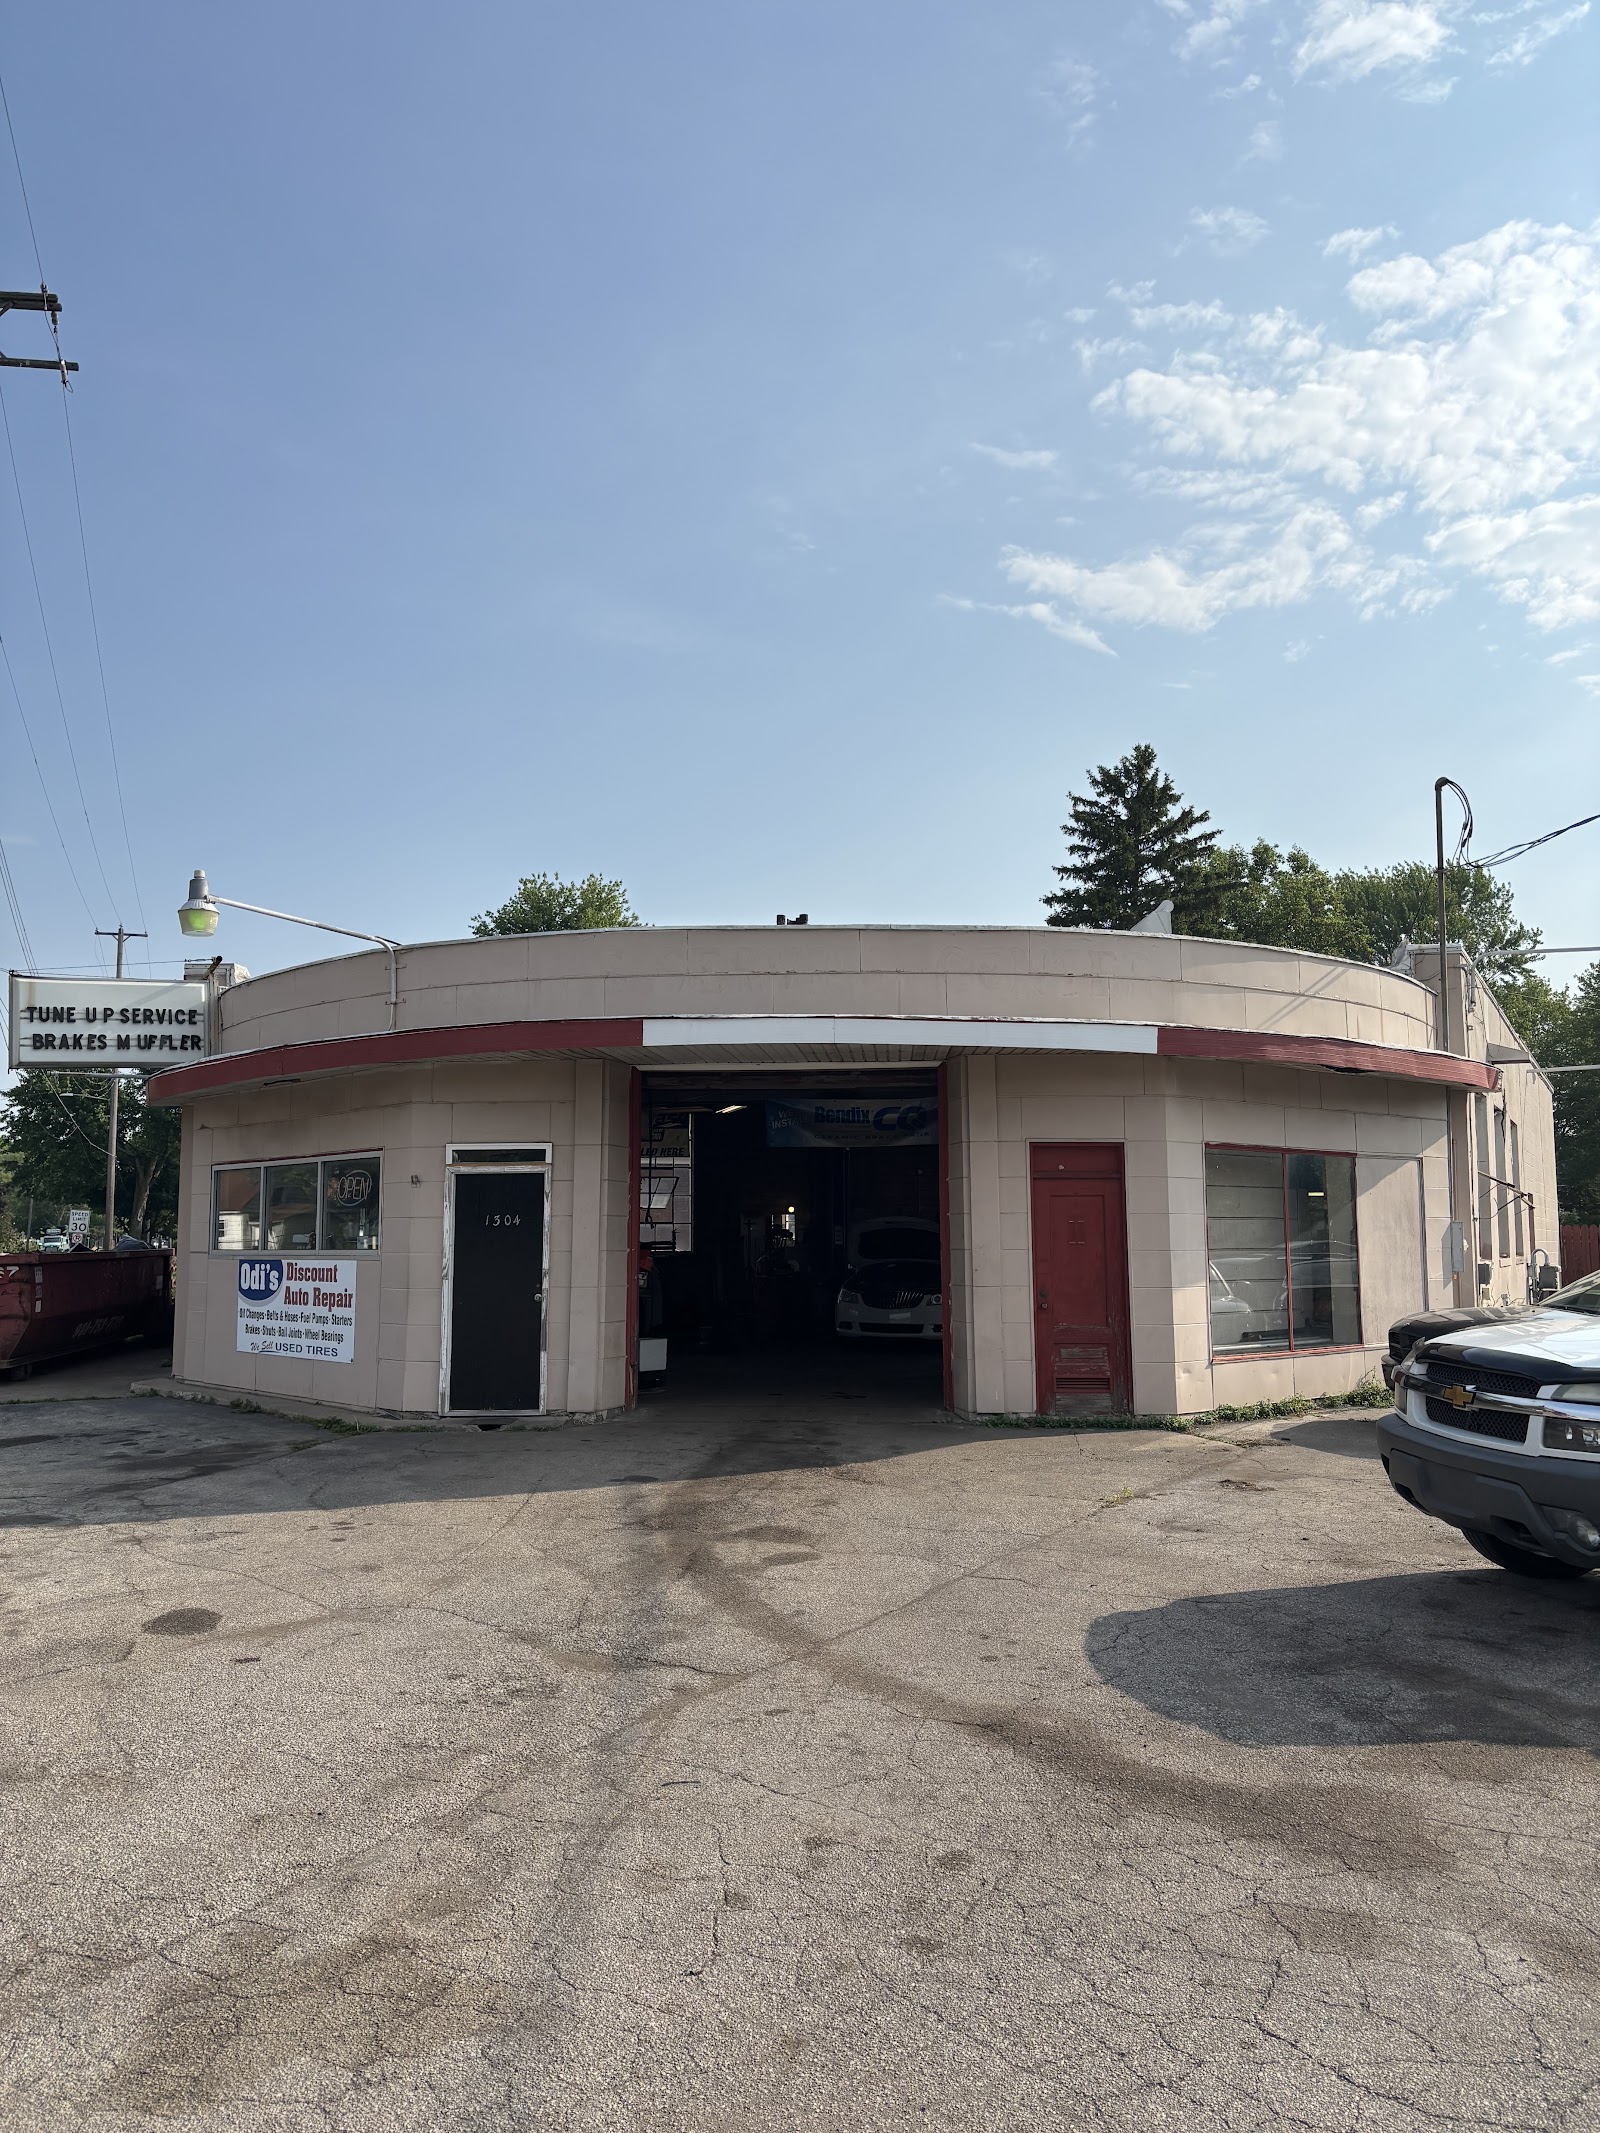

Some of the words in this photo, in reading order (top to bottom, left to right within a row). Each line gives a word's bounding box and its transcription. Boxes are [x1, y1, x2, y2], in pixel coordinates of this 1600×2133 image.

[27, 1006, 76, 1023] TUNE
[86, 1007, 114, 1023] UP
[119, 1008, 197, 1025] SERVICE
[32, 1033, 107, 1050] BRAKES
[117, 1034, 201, 1051] MUFFLER
[778, 1109, 793, 1119] WE
[814, 1105, 870, 1124] Bendix
[660, 1147, 685, 1156] HERE
[338, 1176, 370, 1200] OPEN
[71, 1222, 87, 1232] 30
[485, 1214, 521, 1227] 1304
[240, 1263, 279, 1291] Odi's
[286, 1262, 338, 1283] Discount
[283, 1286, 309, 1306] Auto
[312, 1287, 353, 1312] Repair
[246, 1308, 265, 1321] Changes
[285, 1311, 299, 1323] Hoses
[300, 1312, 311, 1323] Fuel
[312, 1312, 329, 1327] Pumps
[331, 1314, 353, 1327] Starters
[245, 1324, 260, 1335] Brakes
[304, 1328, 320, 1340] Wheel
[321, 1329, 344, 1344] Bearings
[261, 1340, 274, 1350] Sell
[275, 1342, 303, 1353] USED
[305, 1345, 338, 1357] TIRES
